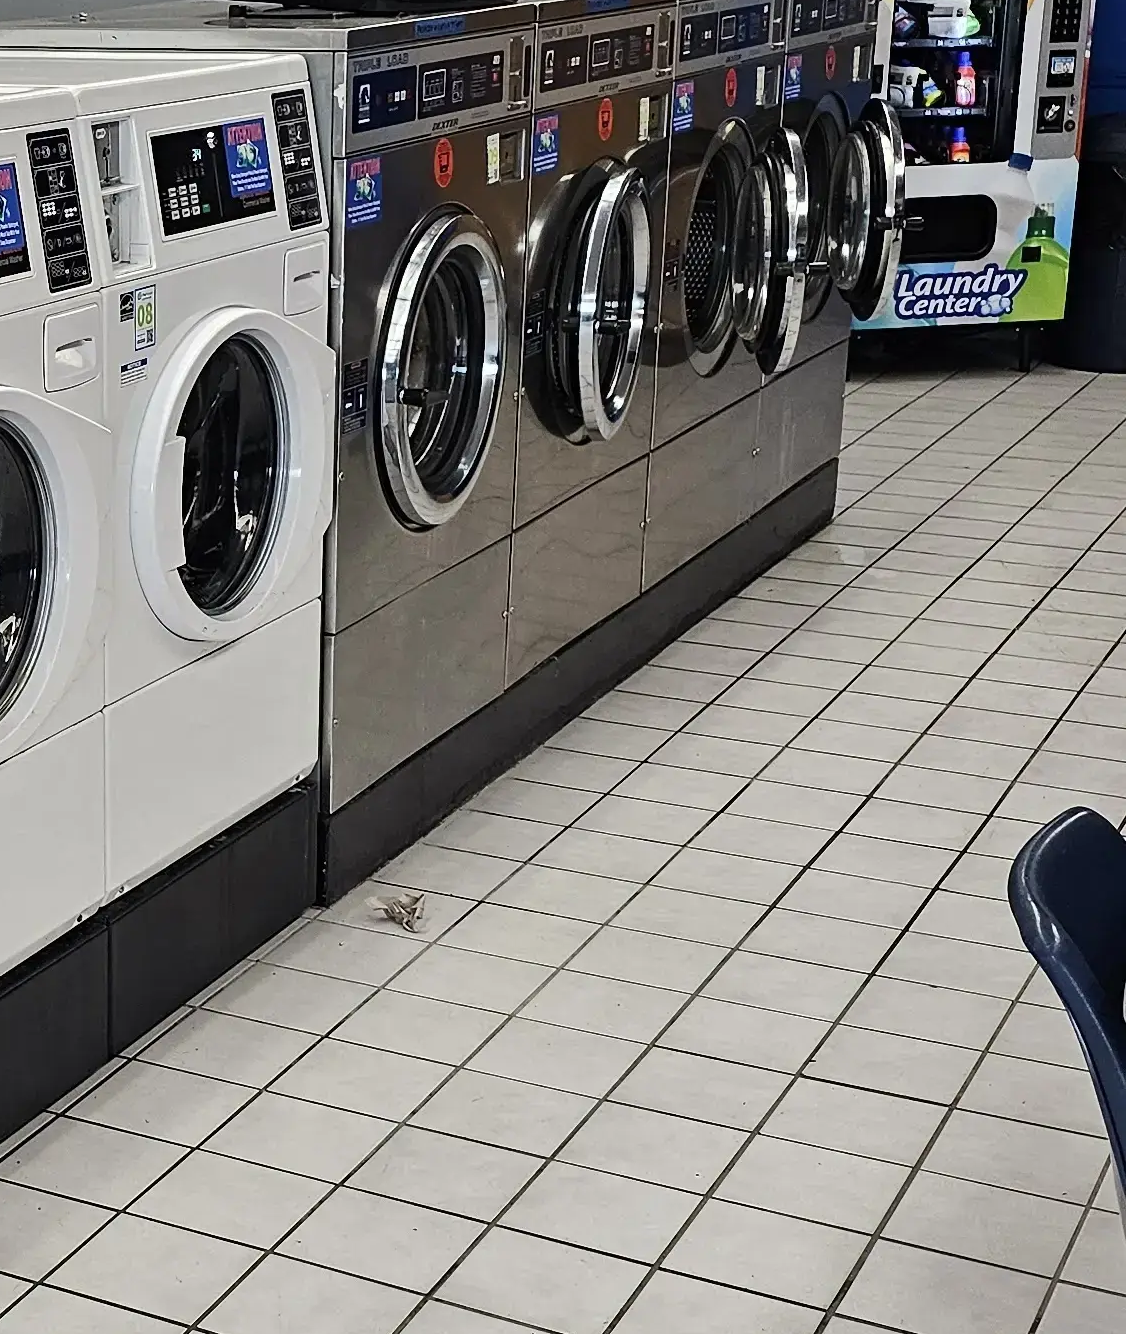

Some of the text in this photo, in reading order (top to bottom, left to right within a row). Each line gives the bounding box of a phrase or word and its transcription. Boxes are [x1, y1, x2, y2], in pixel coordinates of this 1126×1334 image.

[387, 52, 409, 67] LOAD
[432, 118, 459, 132] DEXTER
[898, 267, 1024, 298] Laundry
[137, 302, 153, 327] 08
[898, 294, 982, 316] Center
